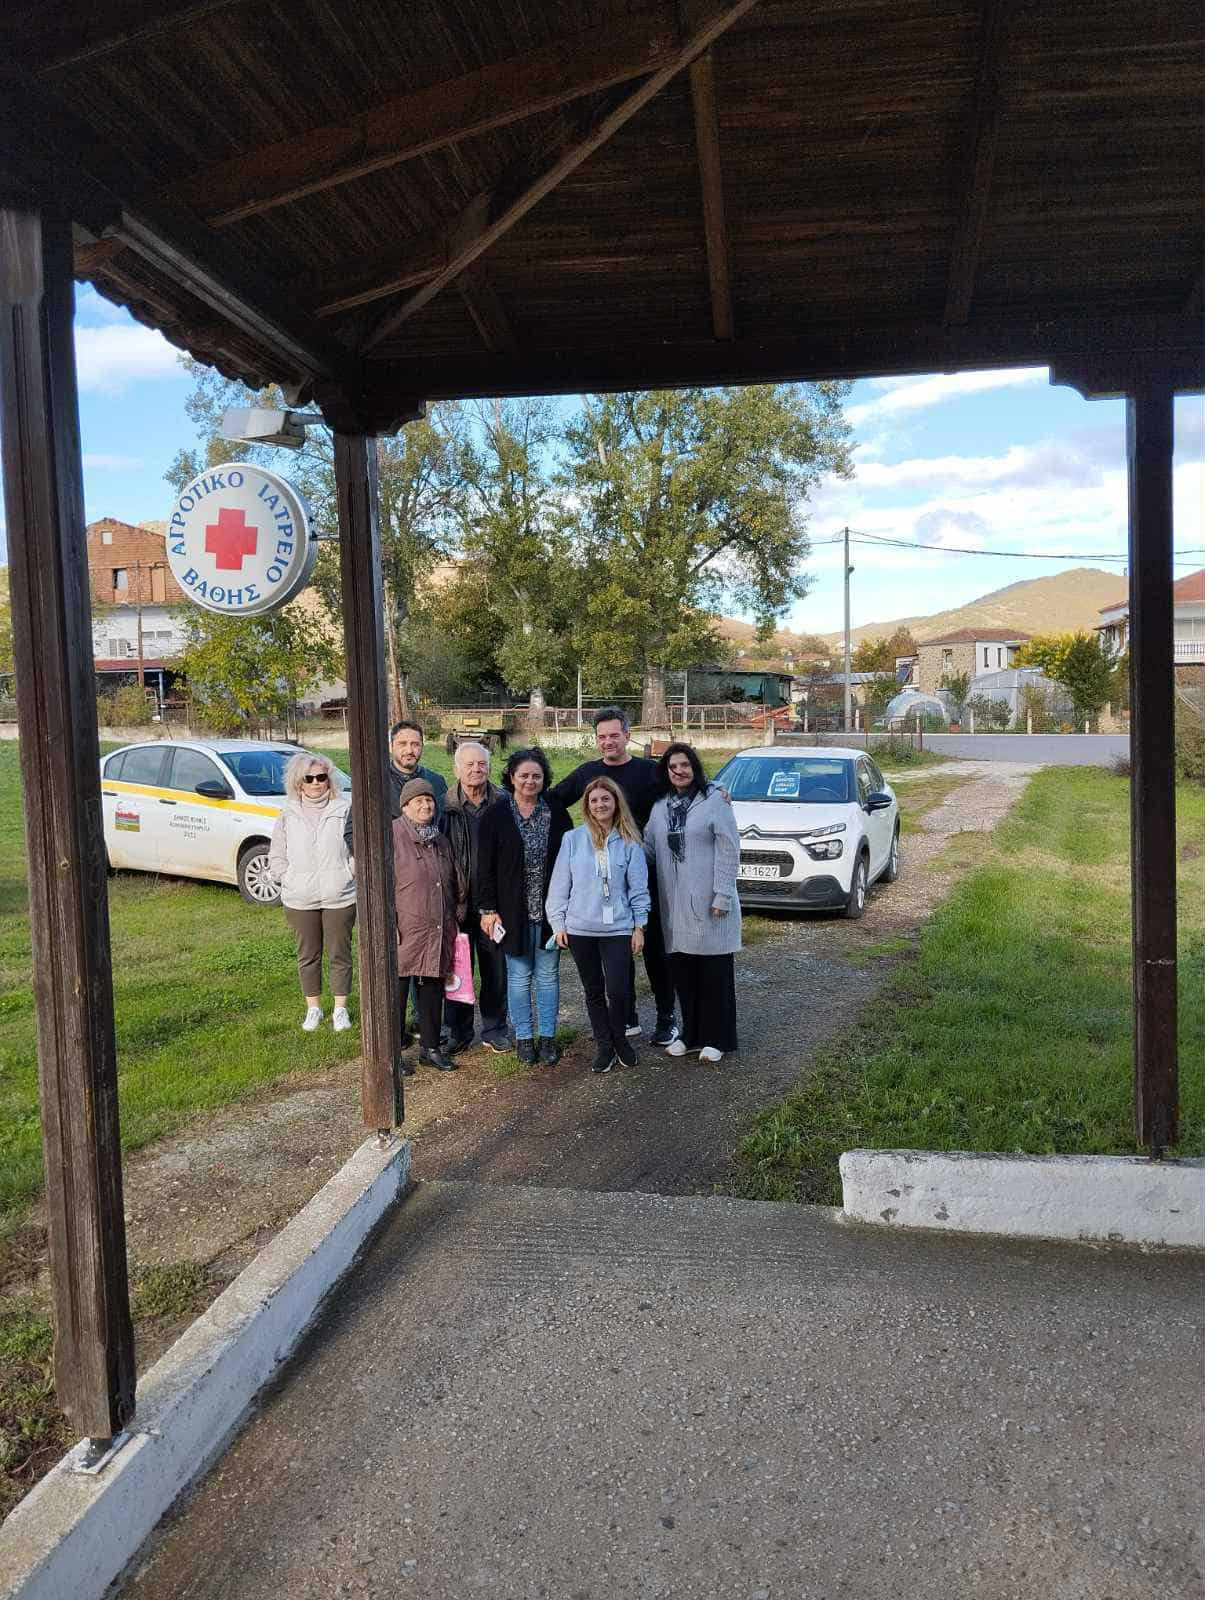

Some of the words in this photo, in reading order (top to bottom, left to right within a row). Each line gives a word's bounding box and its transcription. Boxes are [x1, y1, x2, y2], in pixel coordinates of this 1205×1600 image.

[170, 471, 244, 556] ΑΓΡΟΤΙΚΟ
[257, 484, 293, 583] ΙΑΤΡΕΙΟ
[182, 568, 260, 605] ΒΑΘΗΣ
